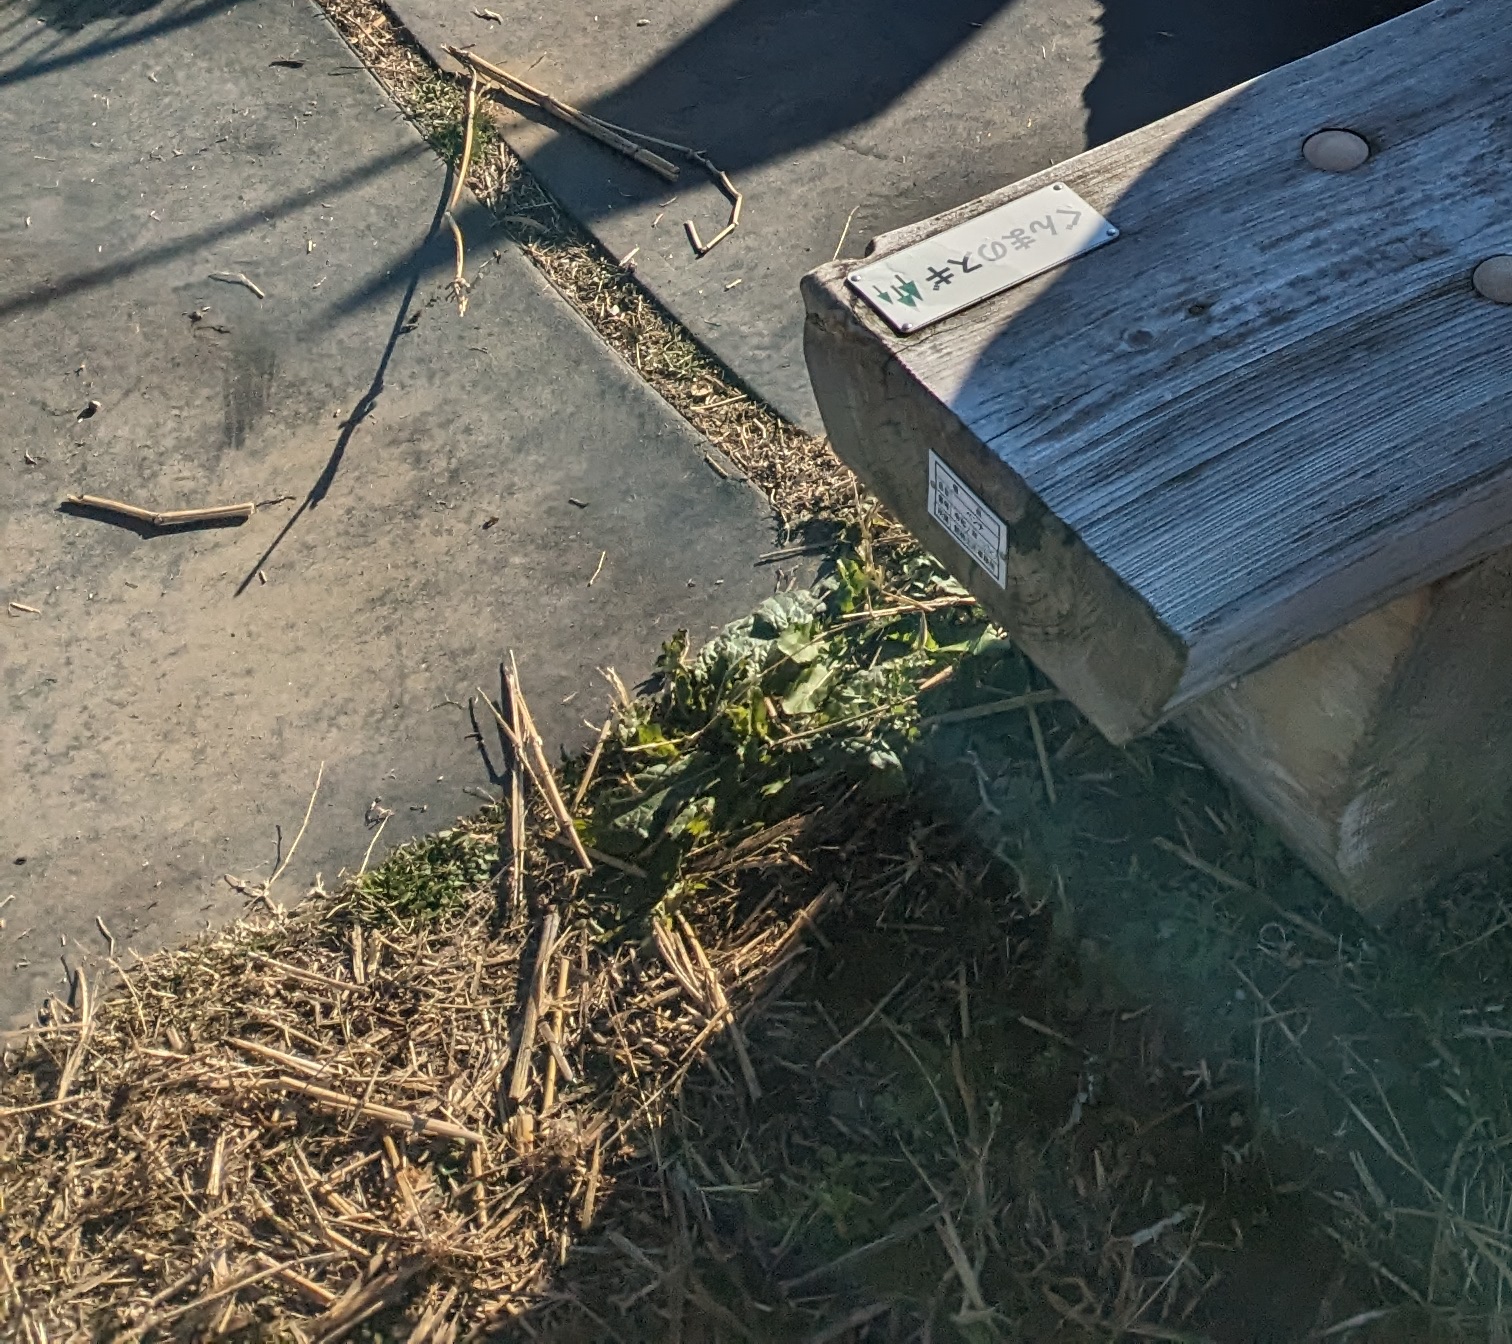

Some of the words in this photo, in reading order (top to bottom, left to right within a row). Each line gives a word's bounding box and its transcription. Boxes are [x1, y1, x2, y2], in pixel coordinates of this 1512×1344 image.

[925, 206, 1083, 292] ぐんまのスギ
